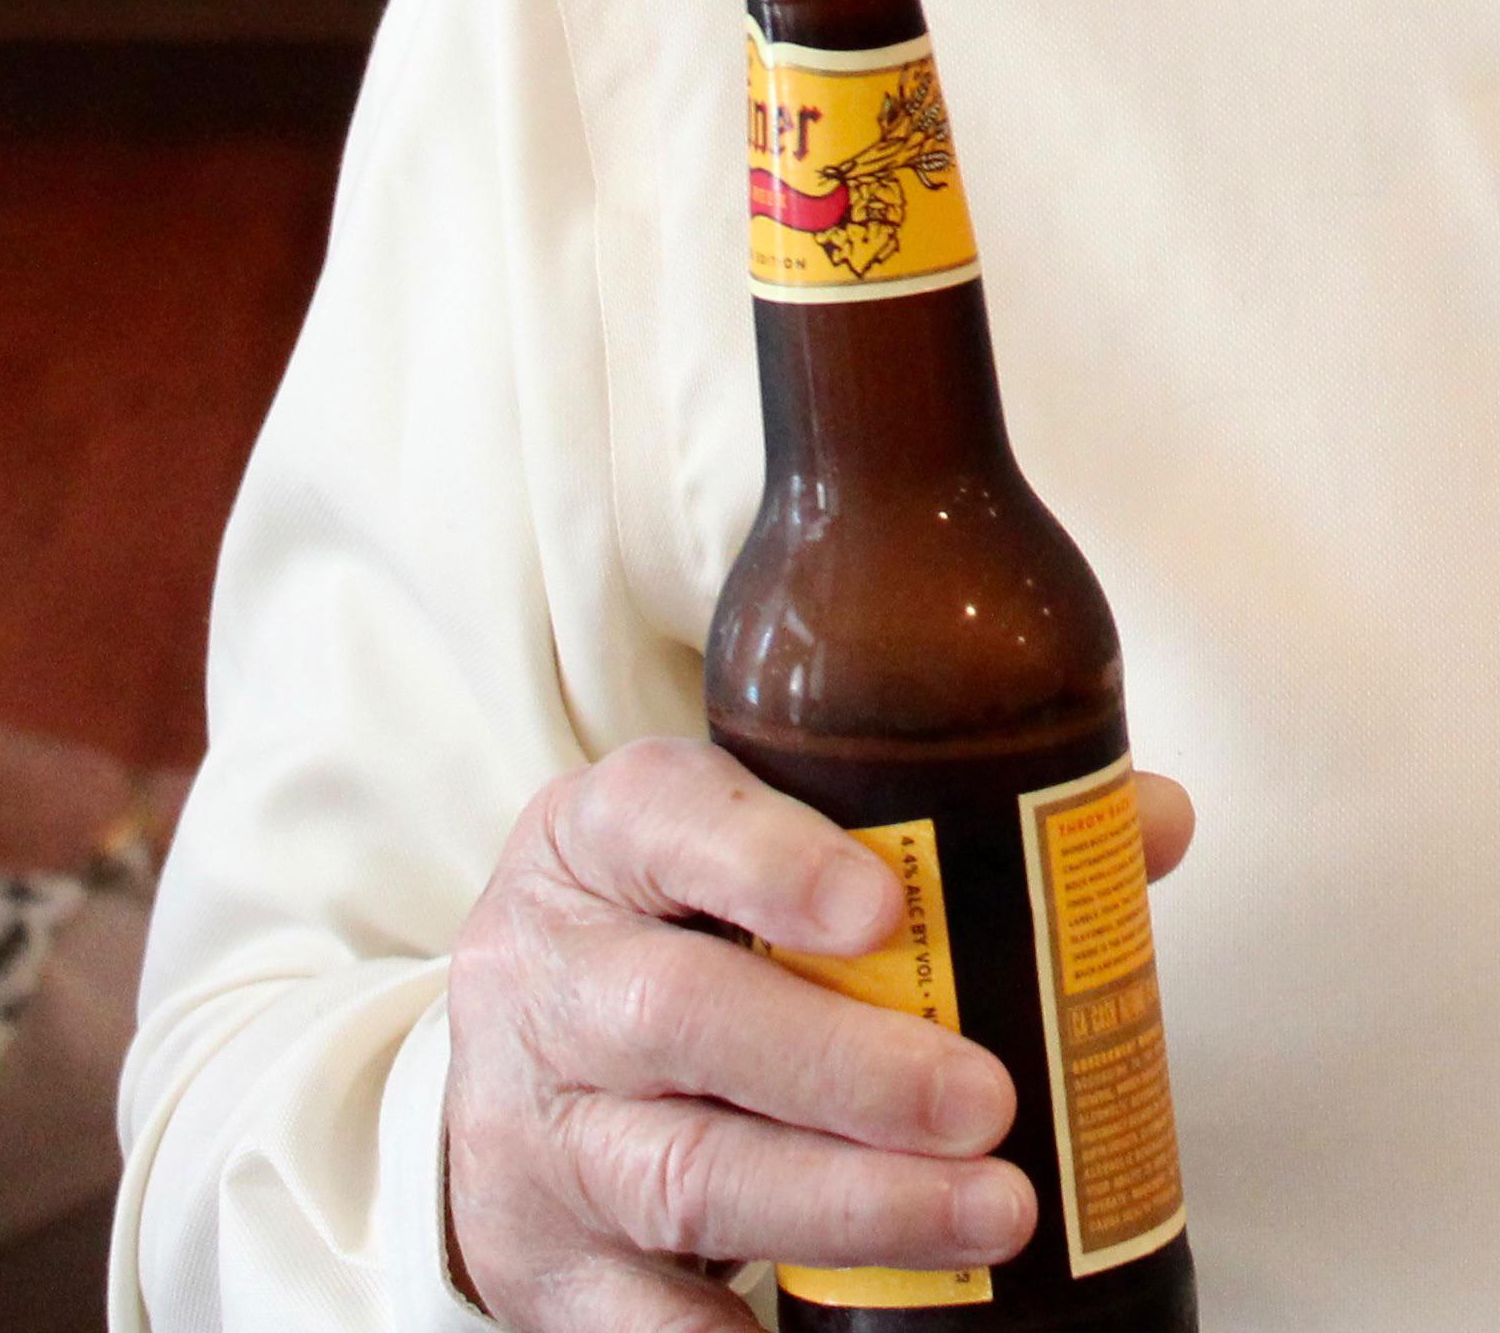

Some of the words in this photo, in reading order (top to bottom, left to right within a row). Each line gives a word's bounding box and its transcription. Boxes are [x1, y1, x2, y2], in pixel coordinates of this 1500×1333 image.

[905, 885, 926, 918] ALC
[911, 924, 928, 947] BY
[915, 952, 933, 988] VOL
